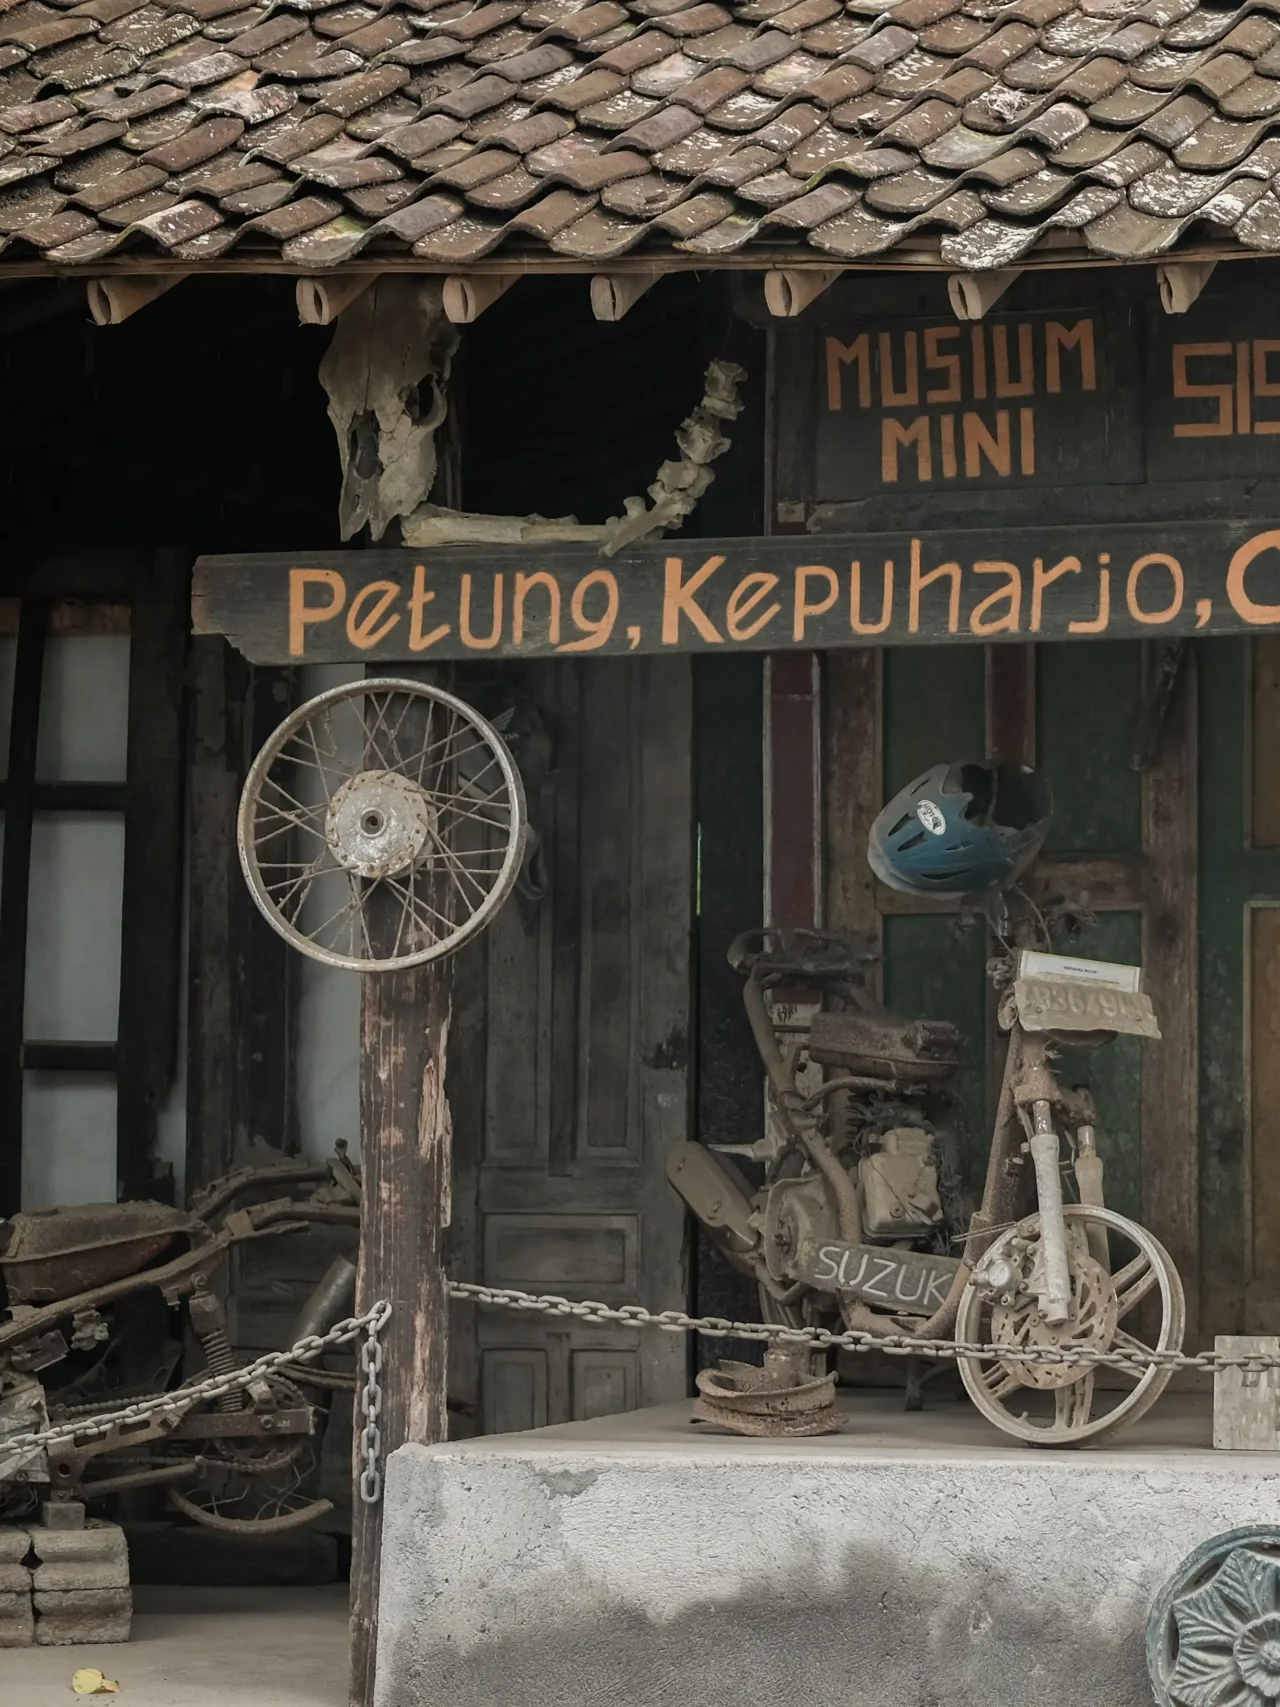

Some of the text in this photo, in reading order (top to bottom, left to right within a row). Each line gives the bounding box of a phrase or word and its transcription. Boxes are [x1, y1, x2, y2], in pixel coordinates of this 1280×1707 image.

[826, 320, 1097, 412] MUSIUM
[880, 408, 1037, 484] MINI
[287, 565, 644, 659] Petung,
[659, 536, 1214, 646] Kepuharjo,
